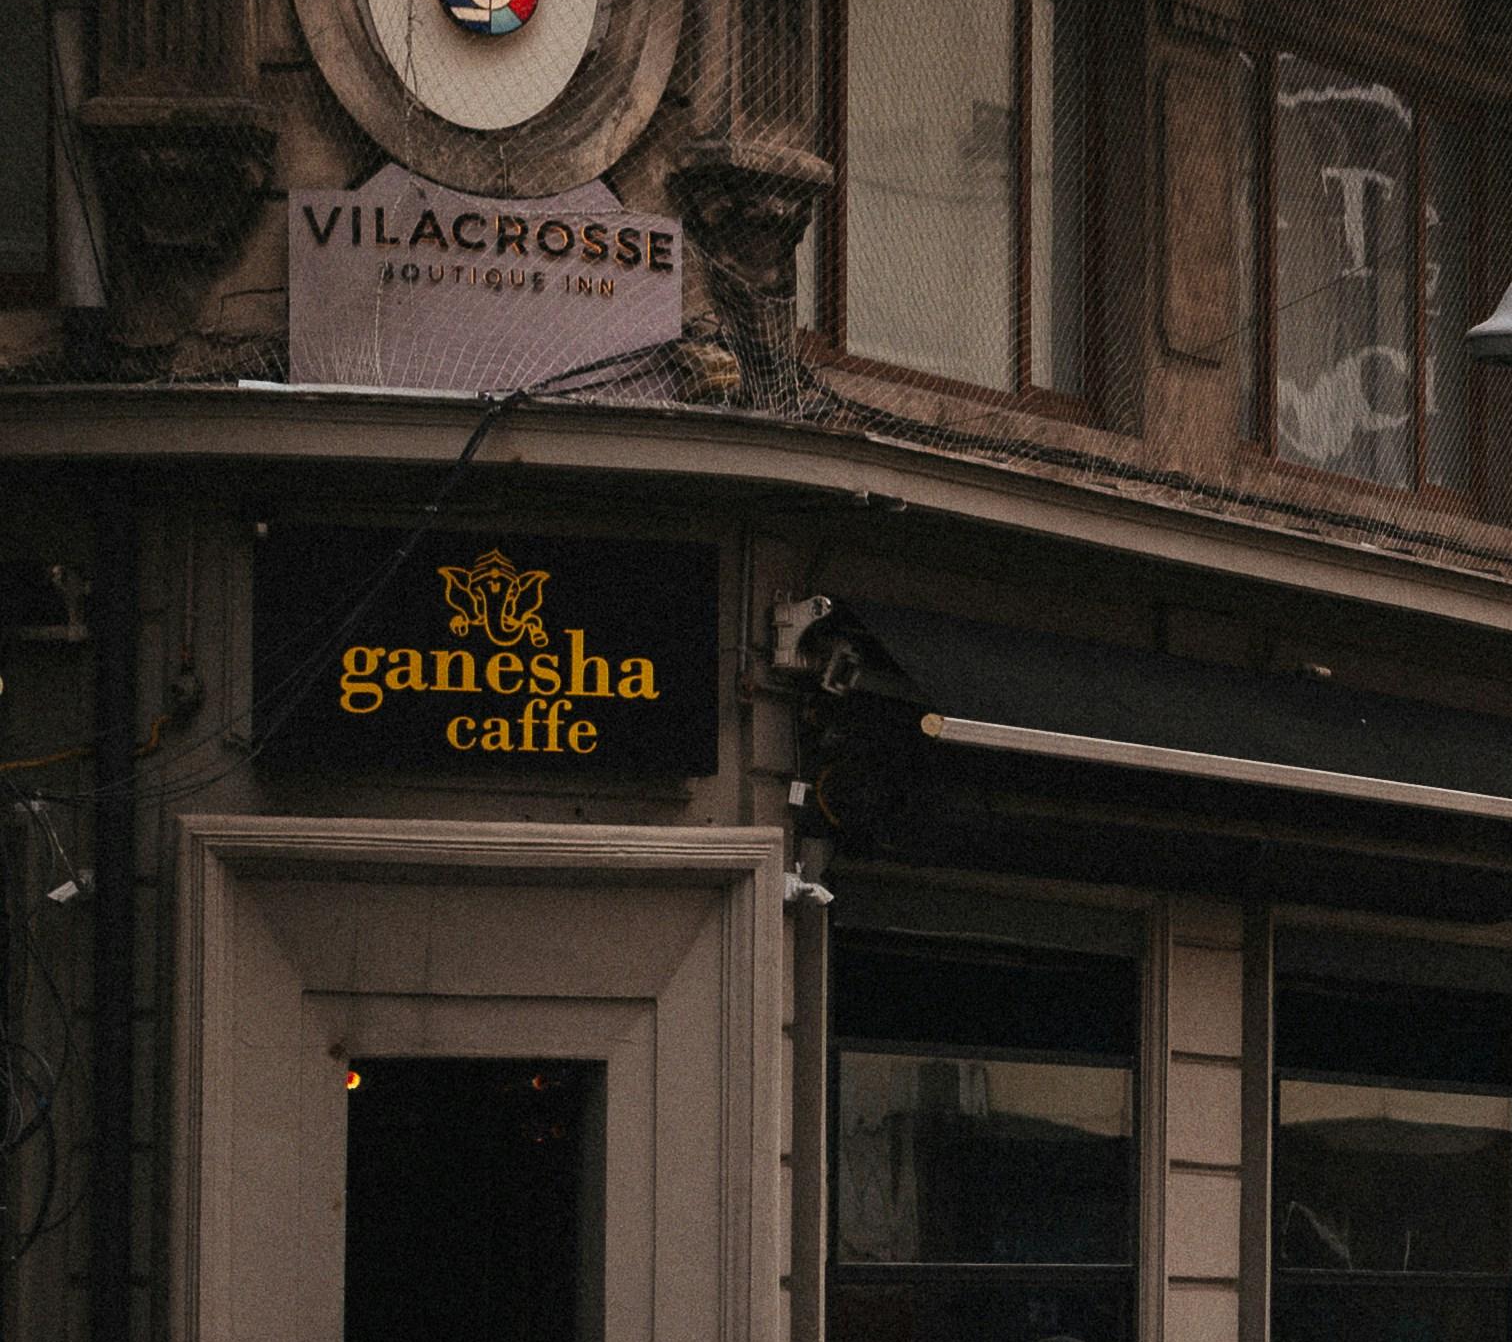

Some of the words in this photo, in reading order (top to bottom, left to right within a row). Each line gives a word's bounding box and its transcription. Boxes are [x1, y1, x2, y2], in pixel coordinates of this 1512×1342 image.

[302, 204, 674, 274] VILACROSSE
[382, 262, 546, 293] BOUTIQUE
[565, 275, 616, 297] INN
[340, 629, 660, 713] ganesha
[446, 698, 598, 754] caffe
